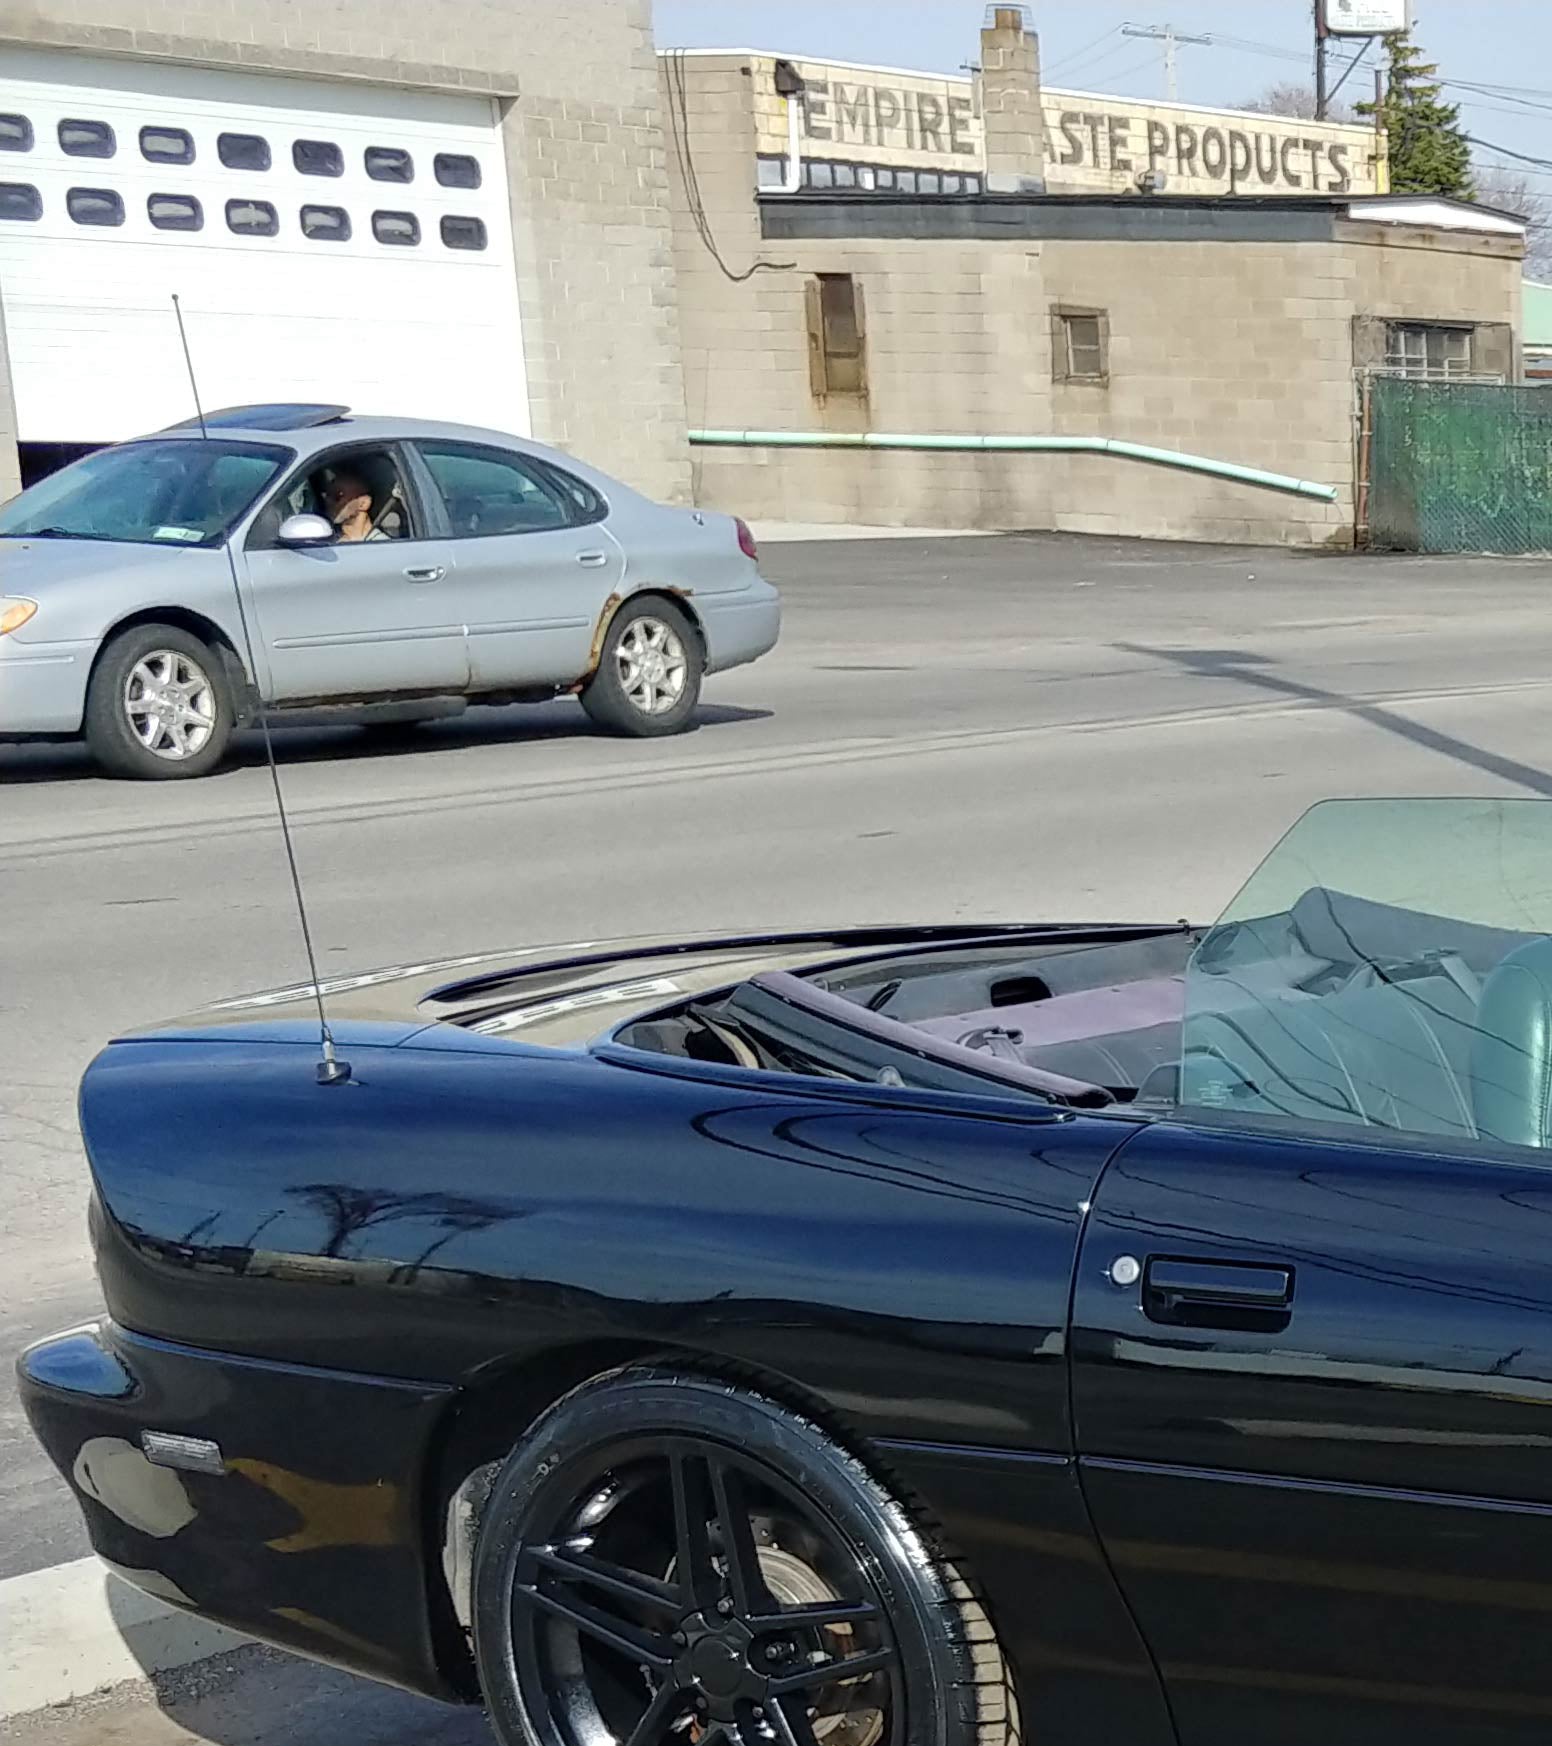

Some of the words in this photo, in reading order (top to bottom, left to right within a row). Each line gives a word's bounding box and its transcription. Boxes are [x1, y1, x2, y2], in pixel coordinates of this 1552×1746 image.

[803, 78, 975, 155] EMPIRE
[1044, 111, 1133, 172] STE
[1147, 119, 1351, 193] PRODUCTS
